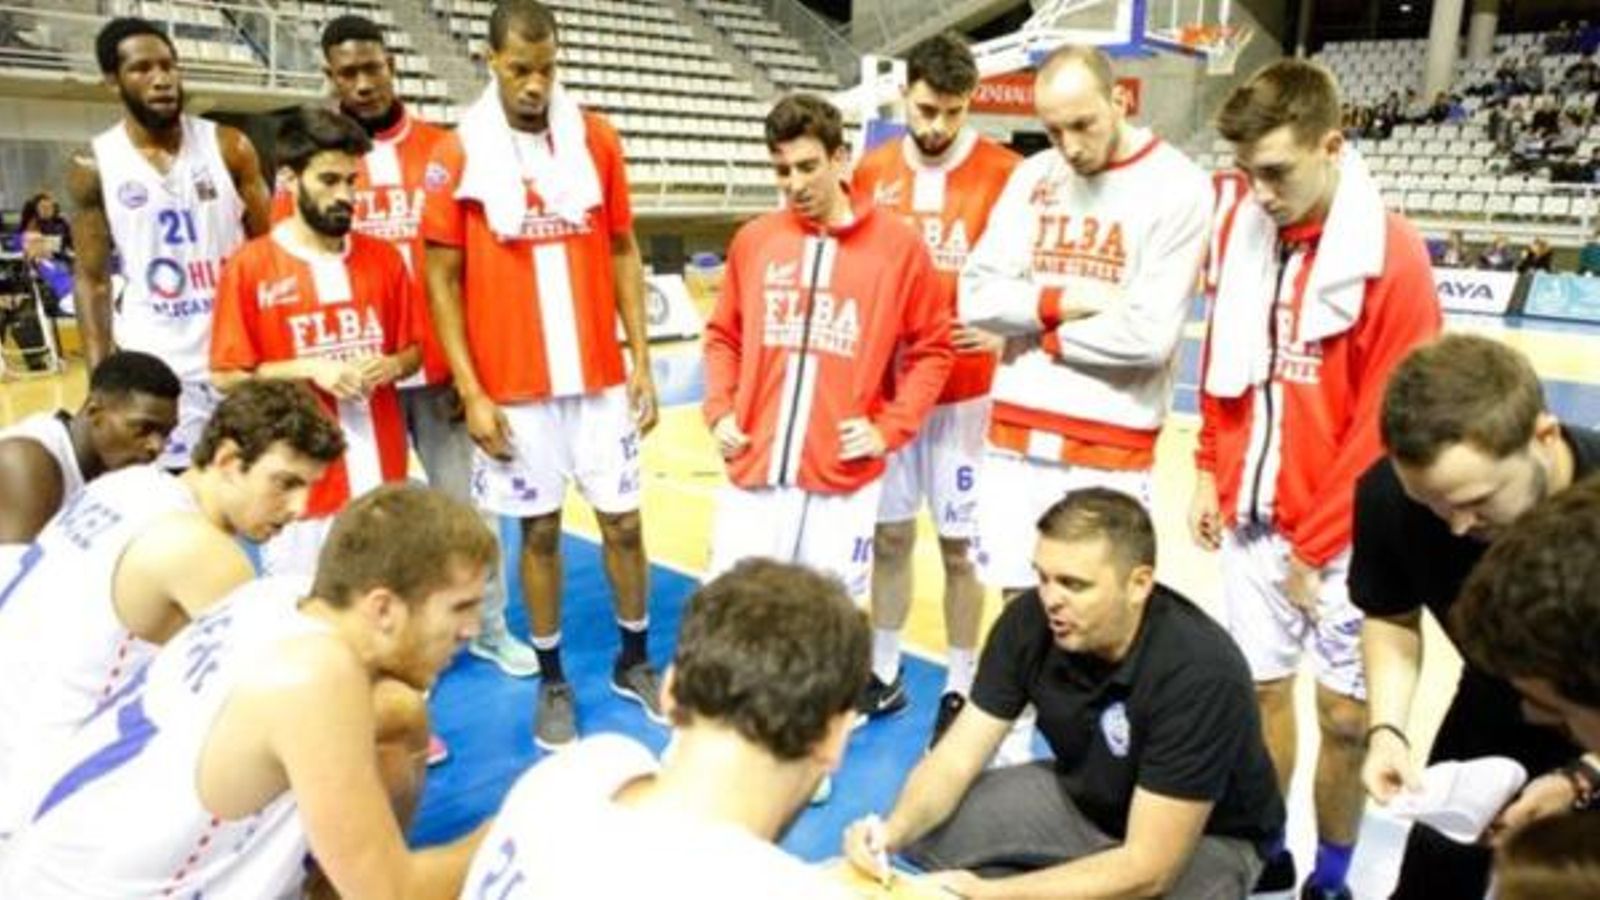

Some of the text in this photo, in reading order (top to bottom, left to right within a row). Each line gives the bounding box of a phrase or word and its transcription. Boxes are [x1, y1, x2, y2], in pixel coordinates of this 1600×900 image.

[158, 209, 197, 243] 21
[289, 305, 384, 347] FLBA
[764, 290, 860, 335] FLBA
[956, 465, 974, 492] 6
